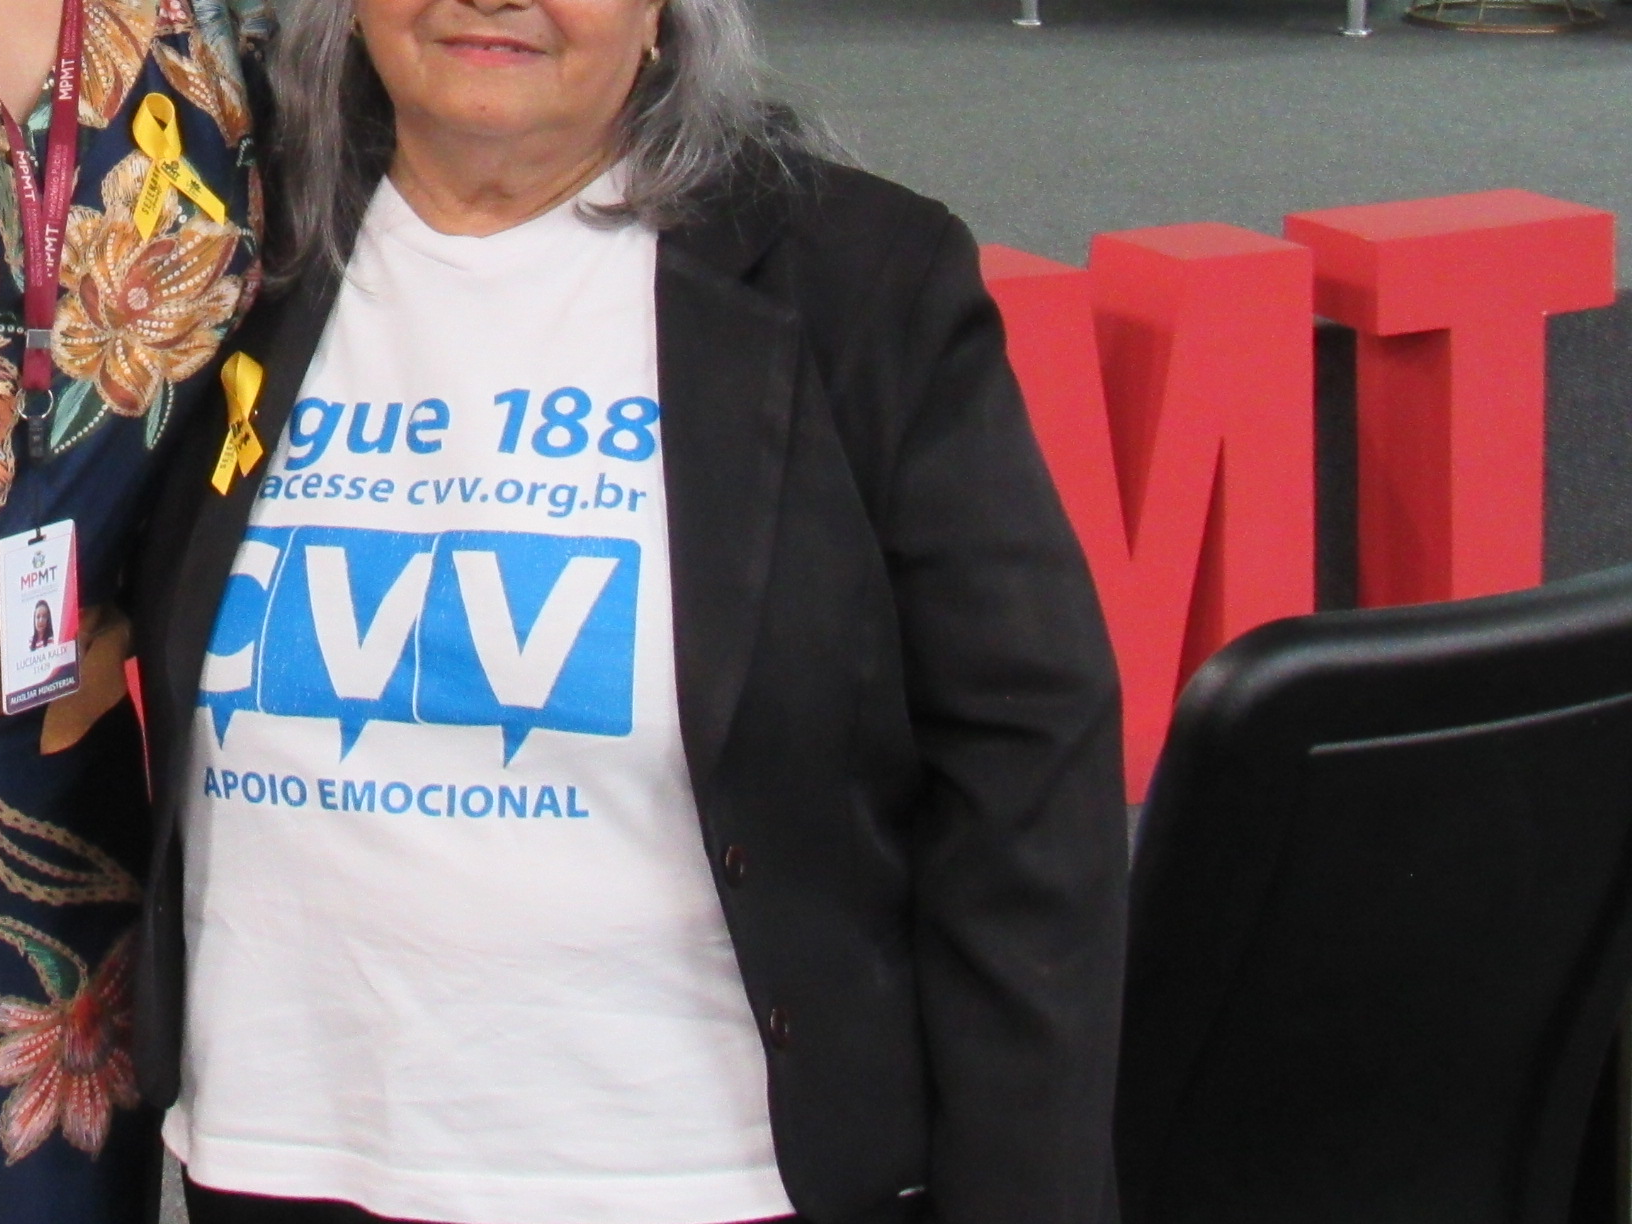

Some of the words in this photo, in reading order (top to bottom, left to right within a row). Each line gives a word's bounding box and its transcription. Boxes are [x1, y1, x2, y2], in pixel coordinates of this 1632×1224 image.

[58, 58, 75, 101] MPMT
[16, 150, 36, 202] MPMT
[493, 386, 661, 462] 188
[260, 473, 396, 504] acesse
[406, 474, 647, 517] cvv.org.br
[20, 565, 57, 590] MPMT
[204, 767, 307, 808] APOIO
[318, 778, 589, 819] EMOCIONAL
